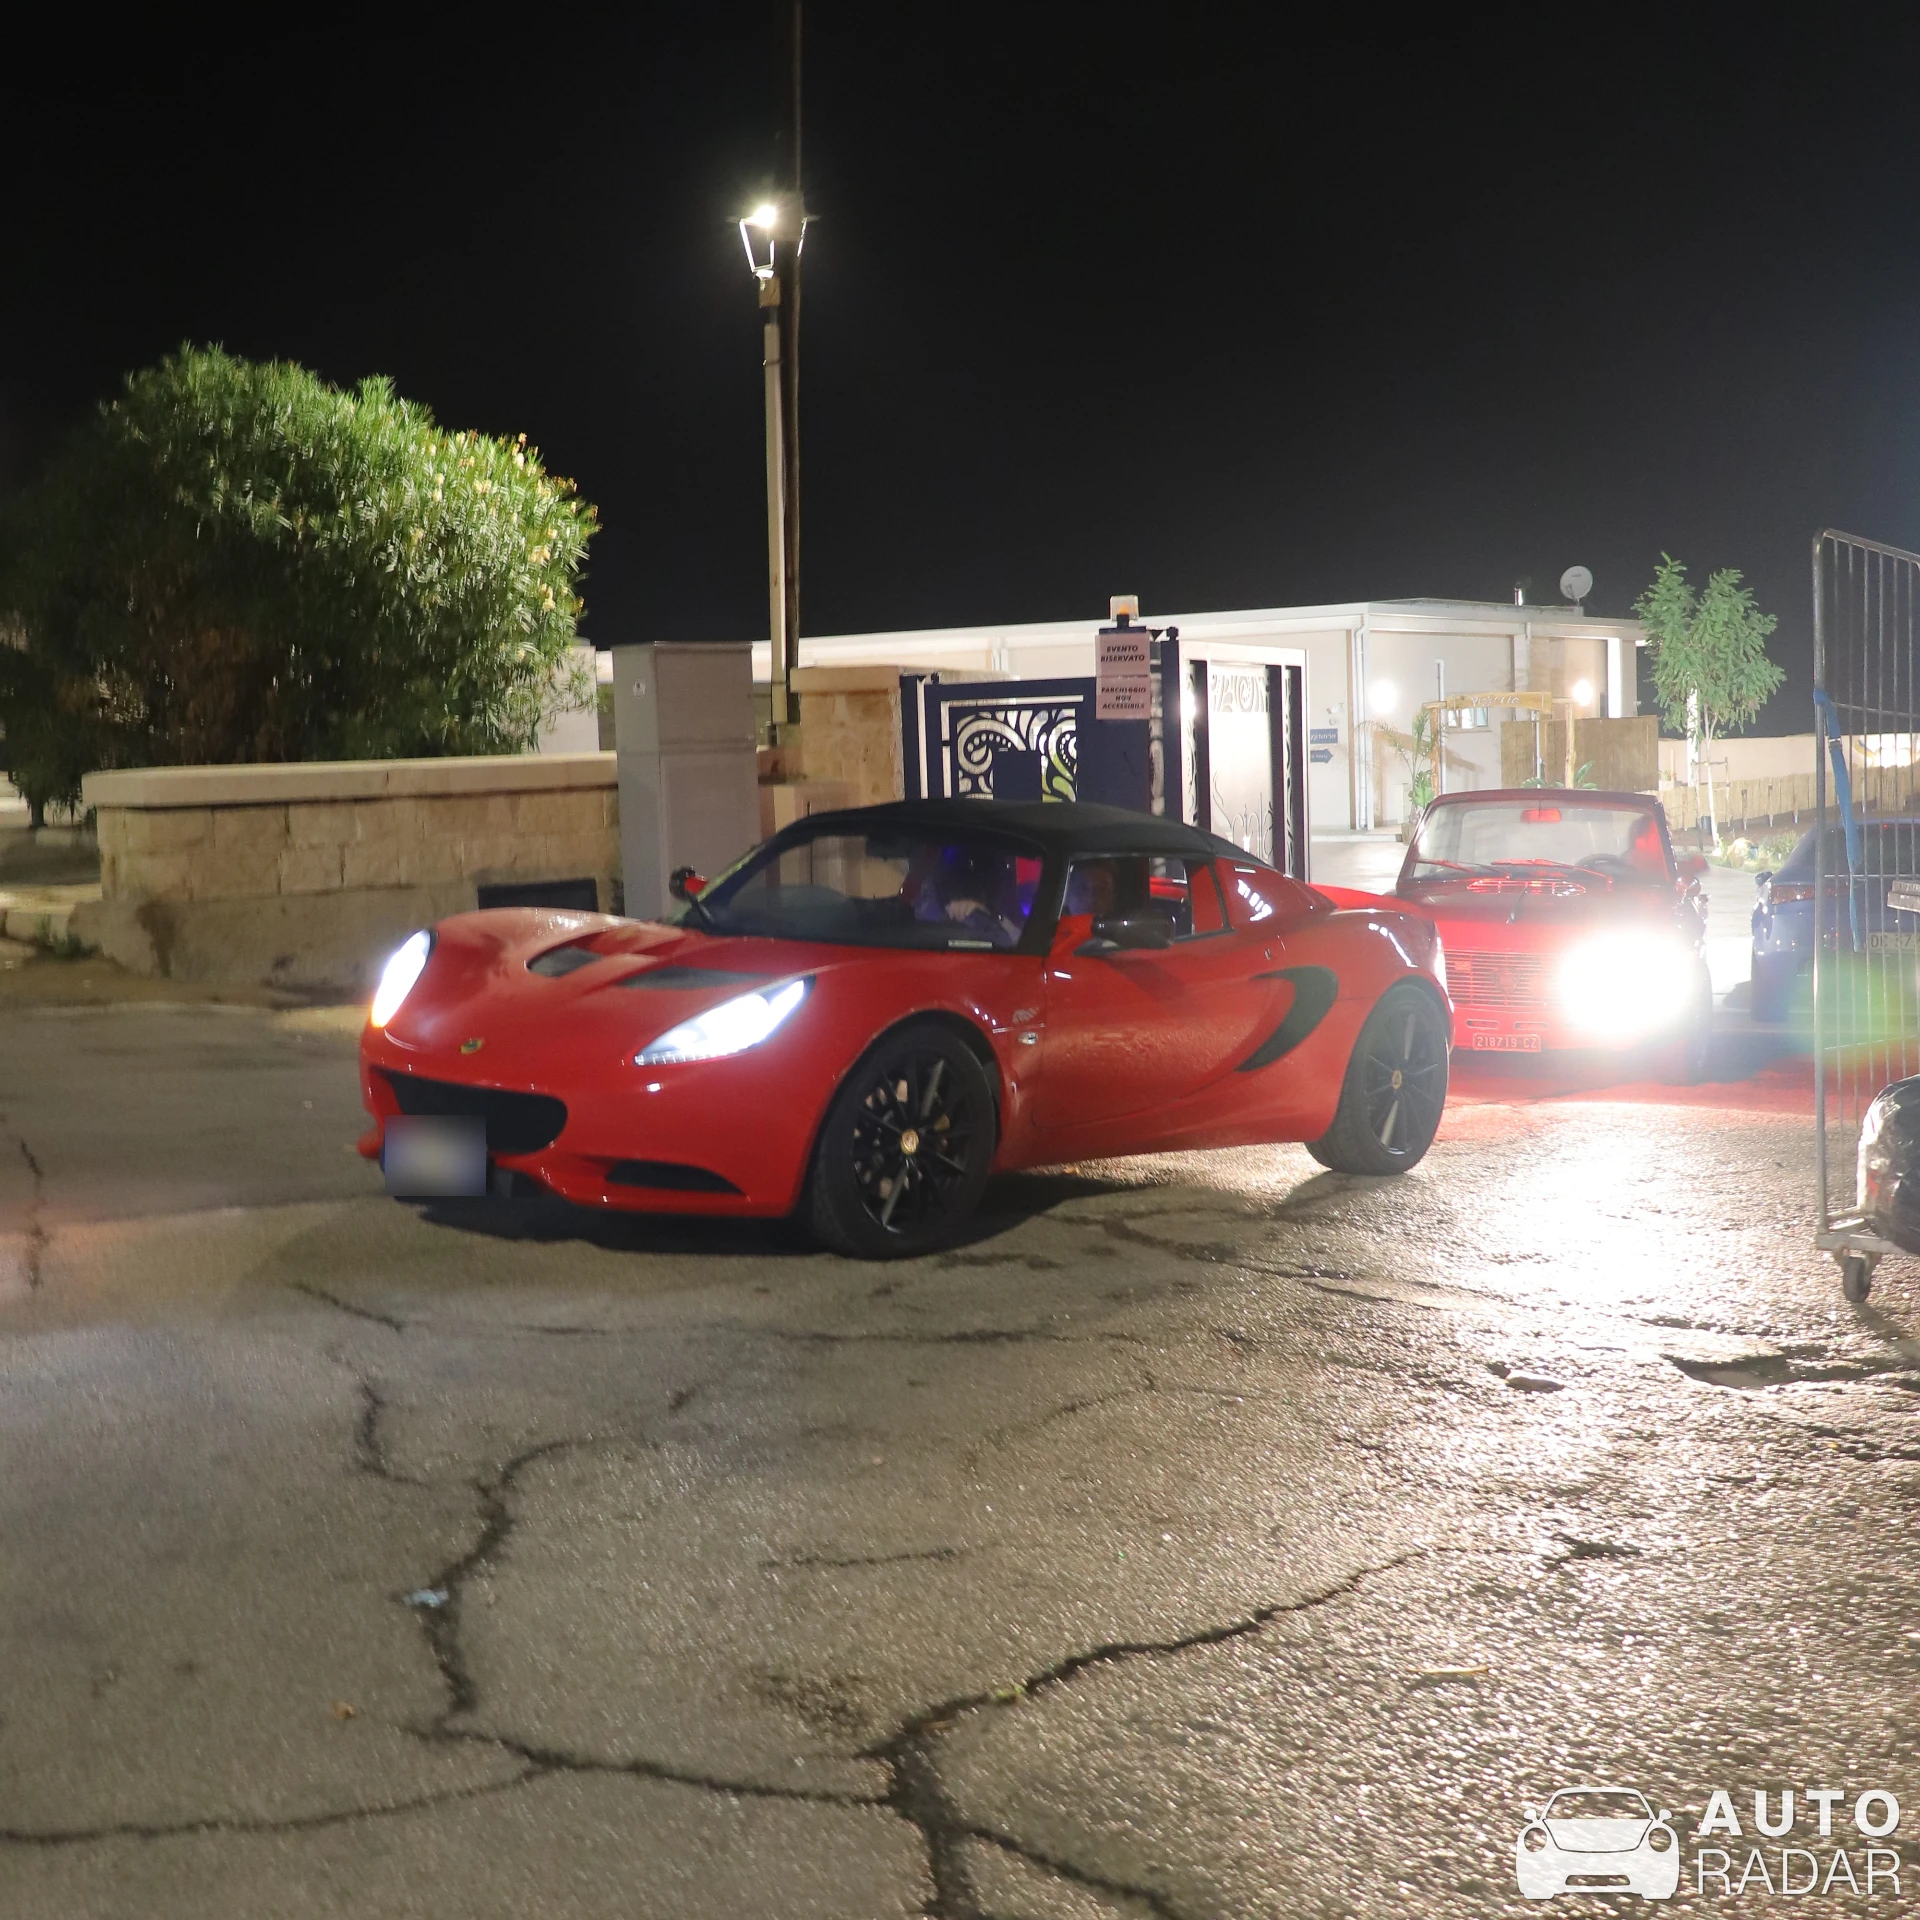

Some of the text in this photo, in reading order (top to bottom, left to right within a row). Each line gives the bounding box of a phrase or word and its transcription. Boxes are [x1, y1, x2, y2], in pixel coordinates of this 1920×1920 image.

[1107, 645, 1139, 653] EVENTO
[1101, 654, 1145, 662] RISERVATO
[1477, 1036, 1537, 1048] 218719 CZ
